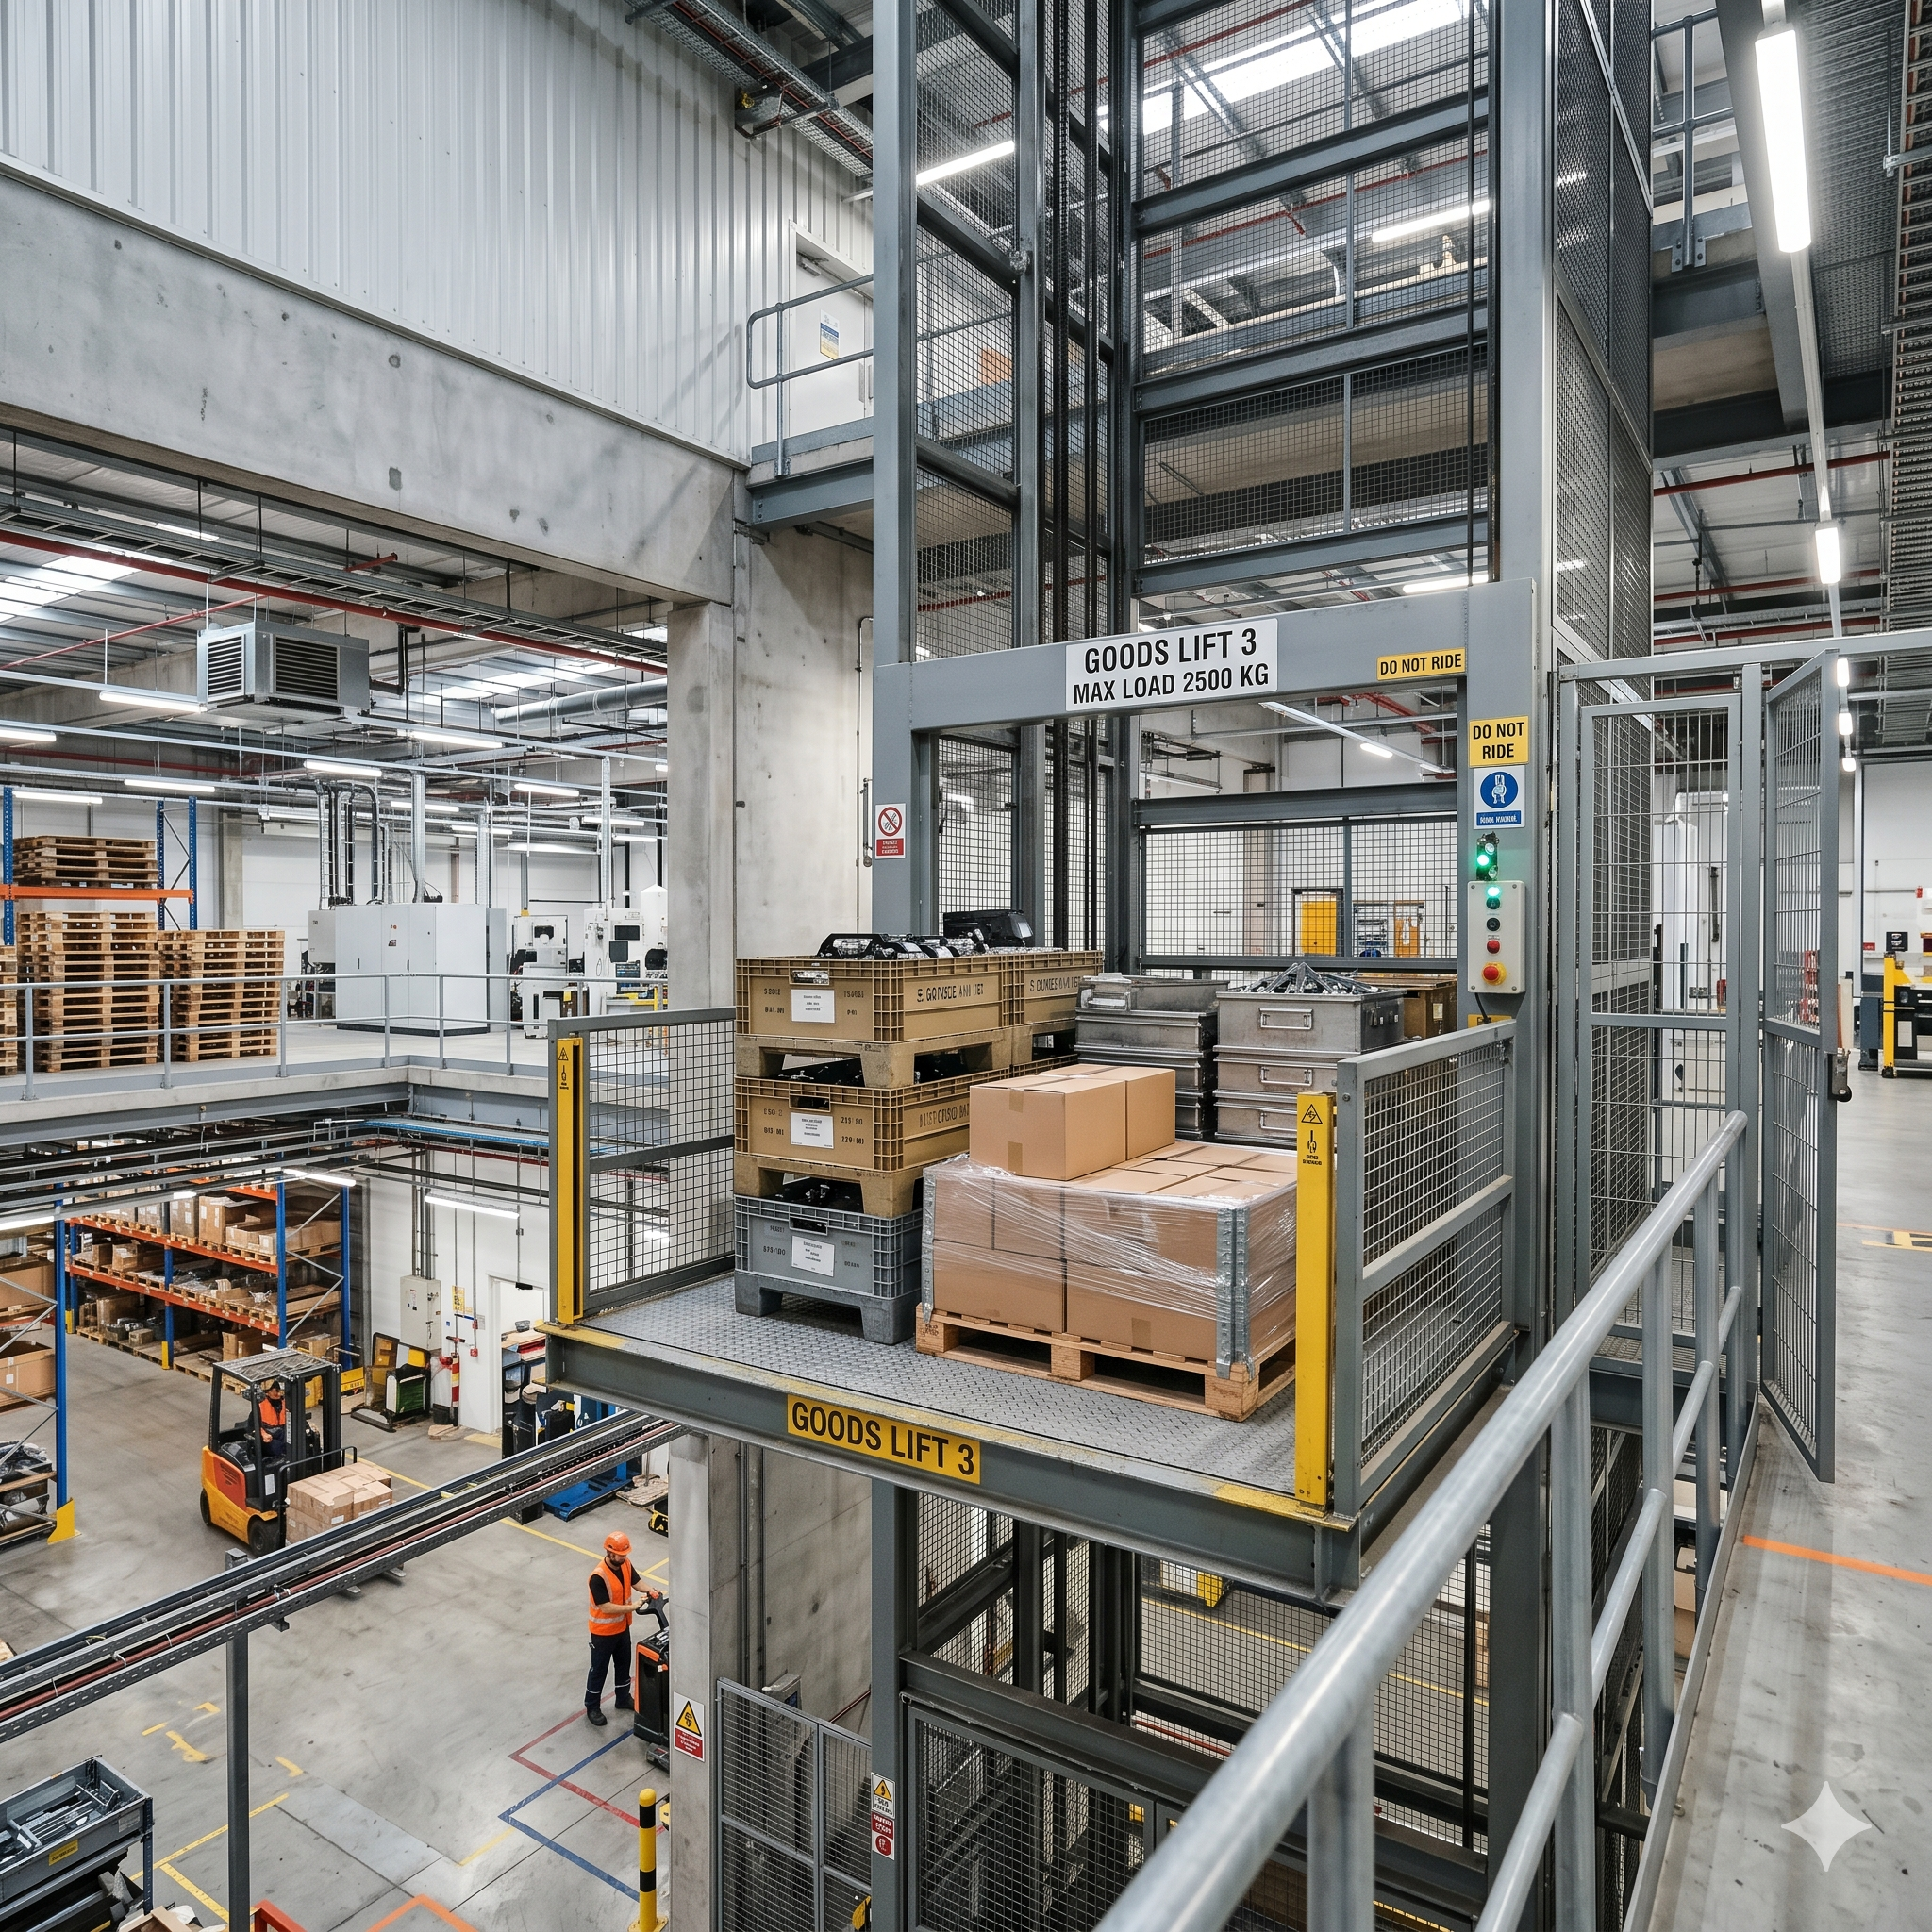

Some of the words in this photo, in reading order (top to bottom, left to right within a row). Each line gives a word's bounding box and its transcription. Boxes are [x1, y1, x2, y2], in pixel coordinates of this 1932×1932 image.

[1085, 639, 1169, 674] GOODS
[1179, 630, 1233, 663] LIFT
[1241, 627, 1257, 656] 3
[1380, 660, 1397, 675] DO
[1402, 657, 1427, 674] NOT
[1431, 653, 1462, 671] RIDE
[1074, 679, 1116, 705] MAX
[1123, 674, 1175, 700] LOAD
[1183, 667, 1232, 693] 2500
[1241, 662, 1269, 687] KG
[1473, 724, 1491, 740] DO
[1496, 722, 1525, 738] NOT
[1482, 743, 1515, 760] RIDE
[791, 1401, 882, 1451] GOODS
[891, 1425, 949, 1468] LIFT
[958, 1443, 974, 1475] 3
